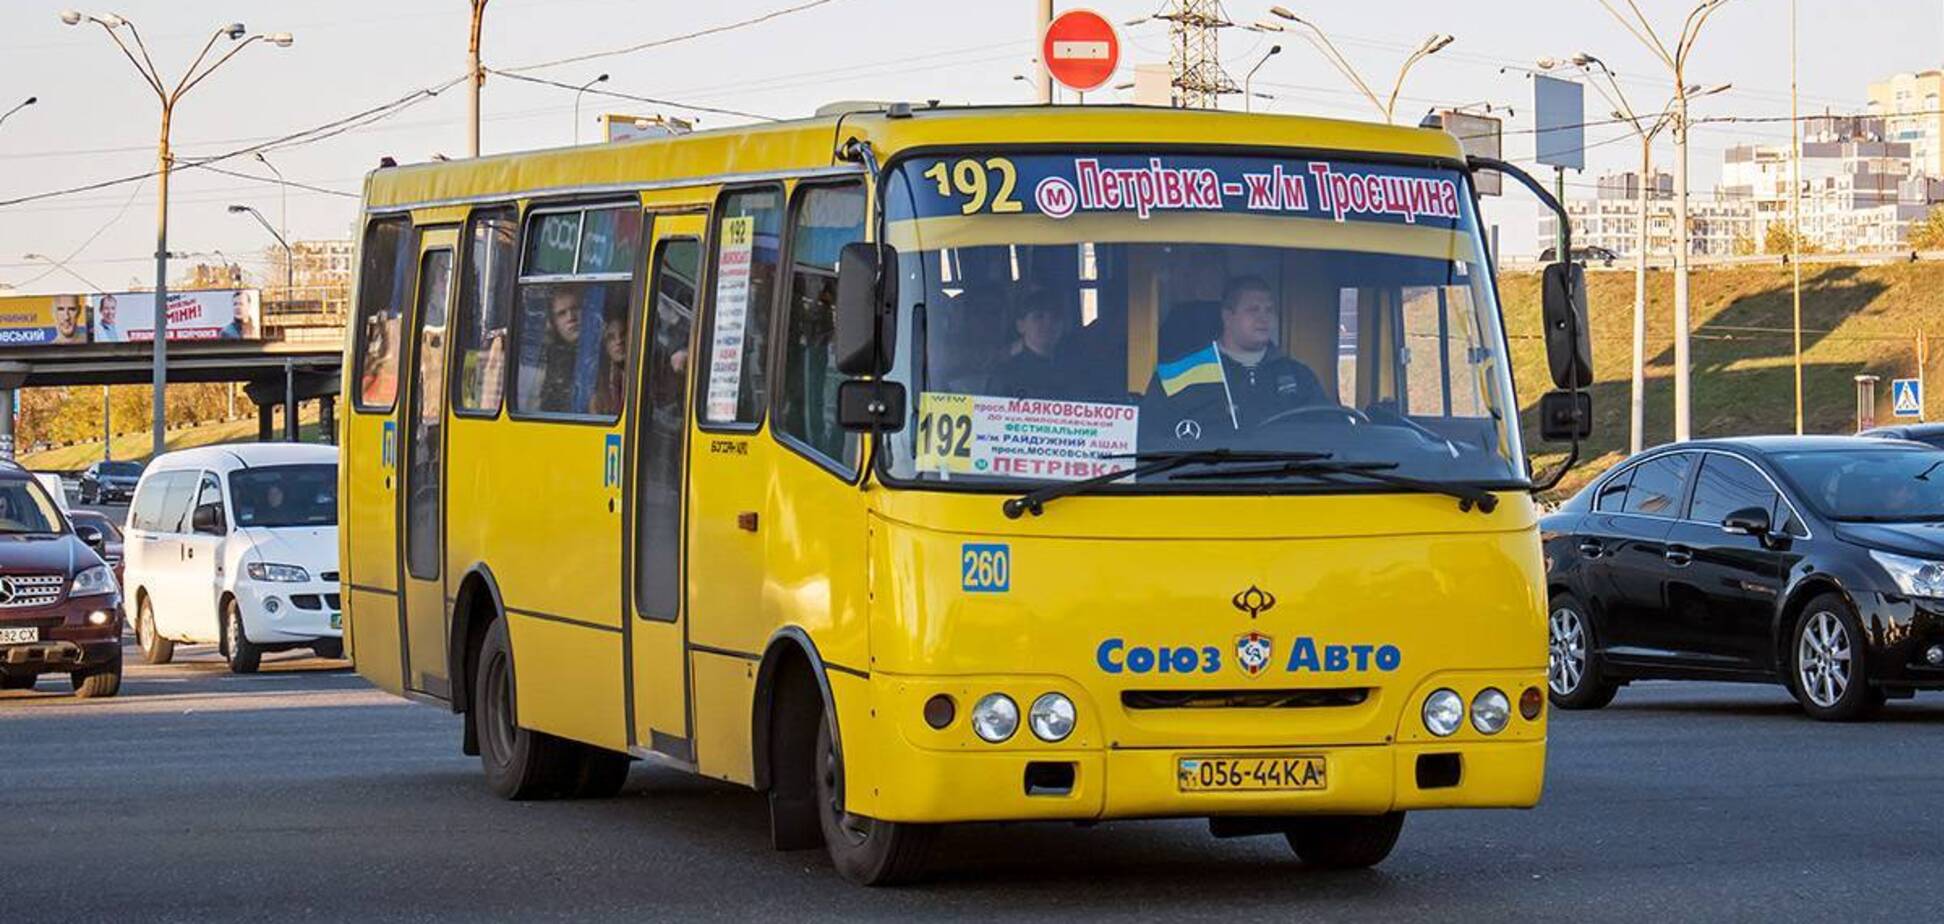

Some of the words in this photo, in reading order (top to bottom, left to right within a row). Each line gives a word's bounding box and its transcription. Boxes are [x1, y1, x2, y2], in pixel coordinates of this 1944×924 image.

[924, 157, 1023, 214] 192
[1076, 157, 1223, 219] Петрівка
[1243, 165, 1308, 210] ж/м
[1308, 162, 1461, 222] Троєщина
[730, 219, 746, 244] 192
[166, 305, 202, 324] МІНИ!
[0, 328, 45, 342] ВСЬКИЙ
[920, 412, 973, 458] 192
[993, 456, 1122, 477] ПЕТРІВКА
[963, 550, 1008, 587] 260
[1096, 638, 1221, 673] Союз
[1286, 637, 1401, 672] Авто
[1200, 760, 1319, 786] 056-44КА
